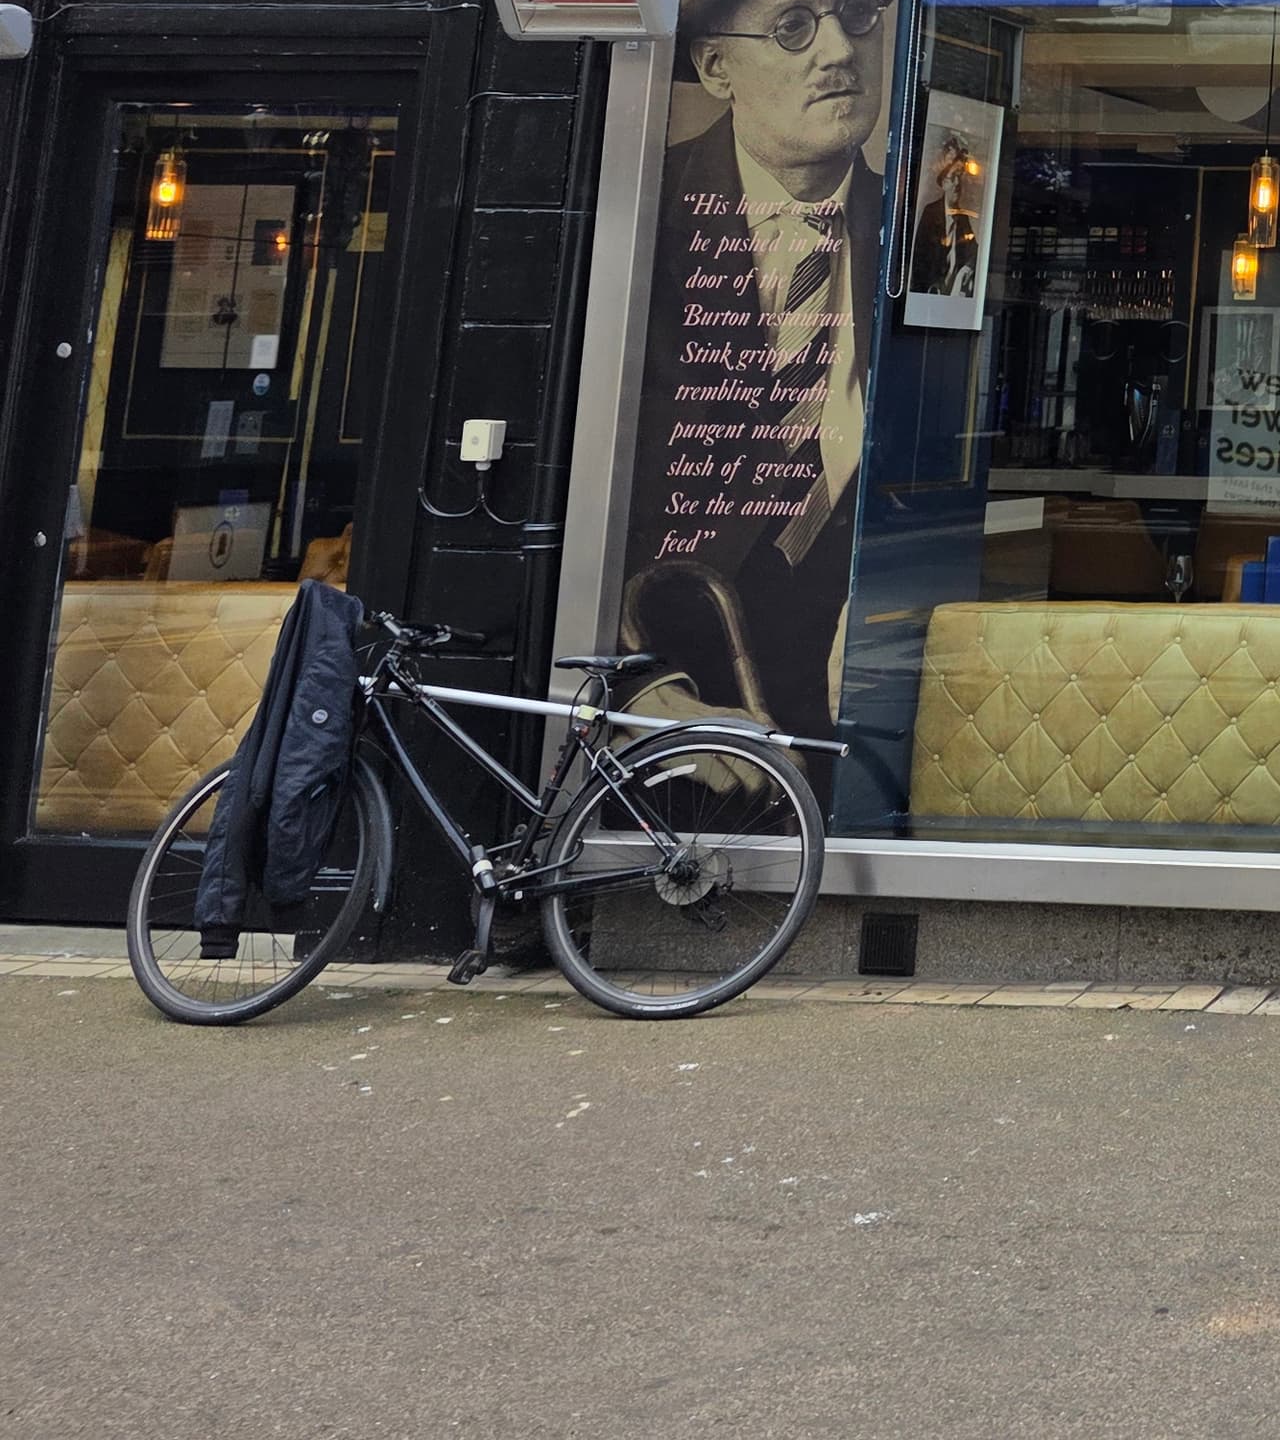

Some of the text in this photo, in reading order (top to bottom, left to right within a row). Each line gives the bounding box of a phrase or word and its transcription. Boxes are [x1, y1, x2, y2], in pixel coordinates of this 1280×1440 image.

[735, 193, 785, 216] heart
[689, 230, 844, 260] he pushed in the
[685, 266, 788, 297] door of the
[683, 303, 751, 327] Burton
[680, 341, 844, 371] Stink gripped his
[674, 378, 765, 409] trembling
[667, 418, 845, 448] pungent meatjuice,
[666, 453, 818, 485] slush of greens.
[664, 491, 812, 517] See the animal
